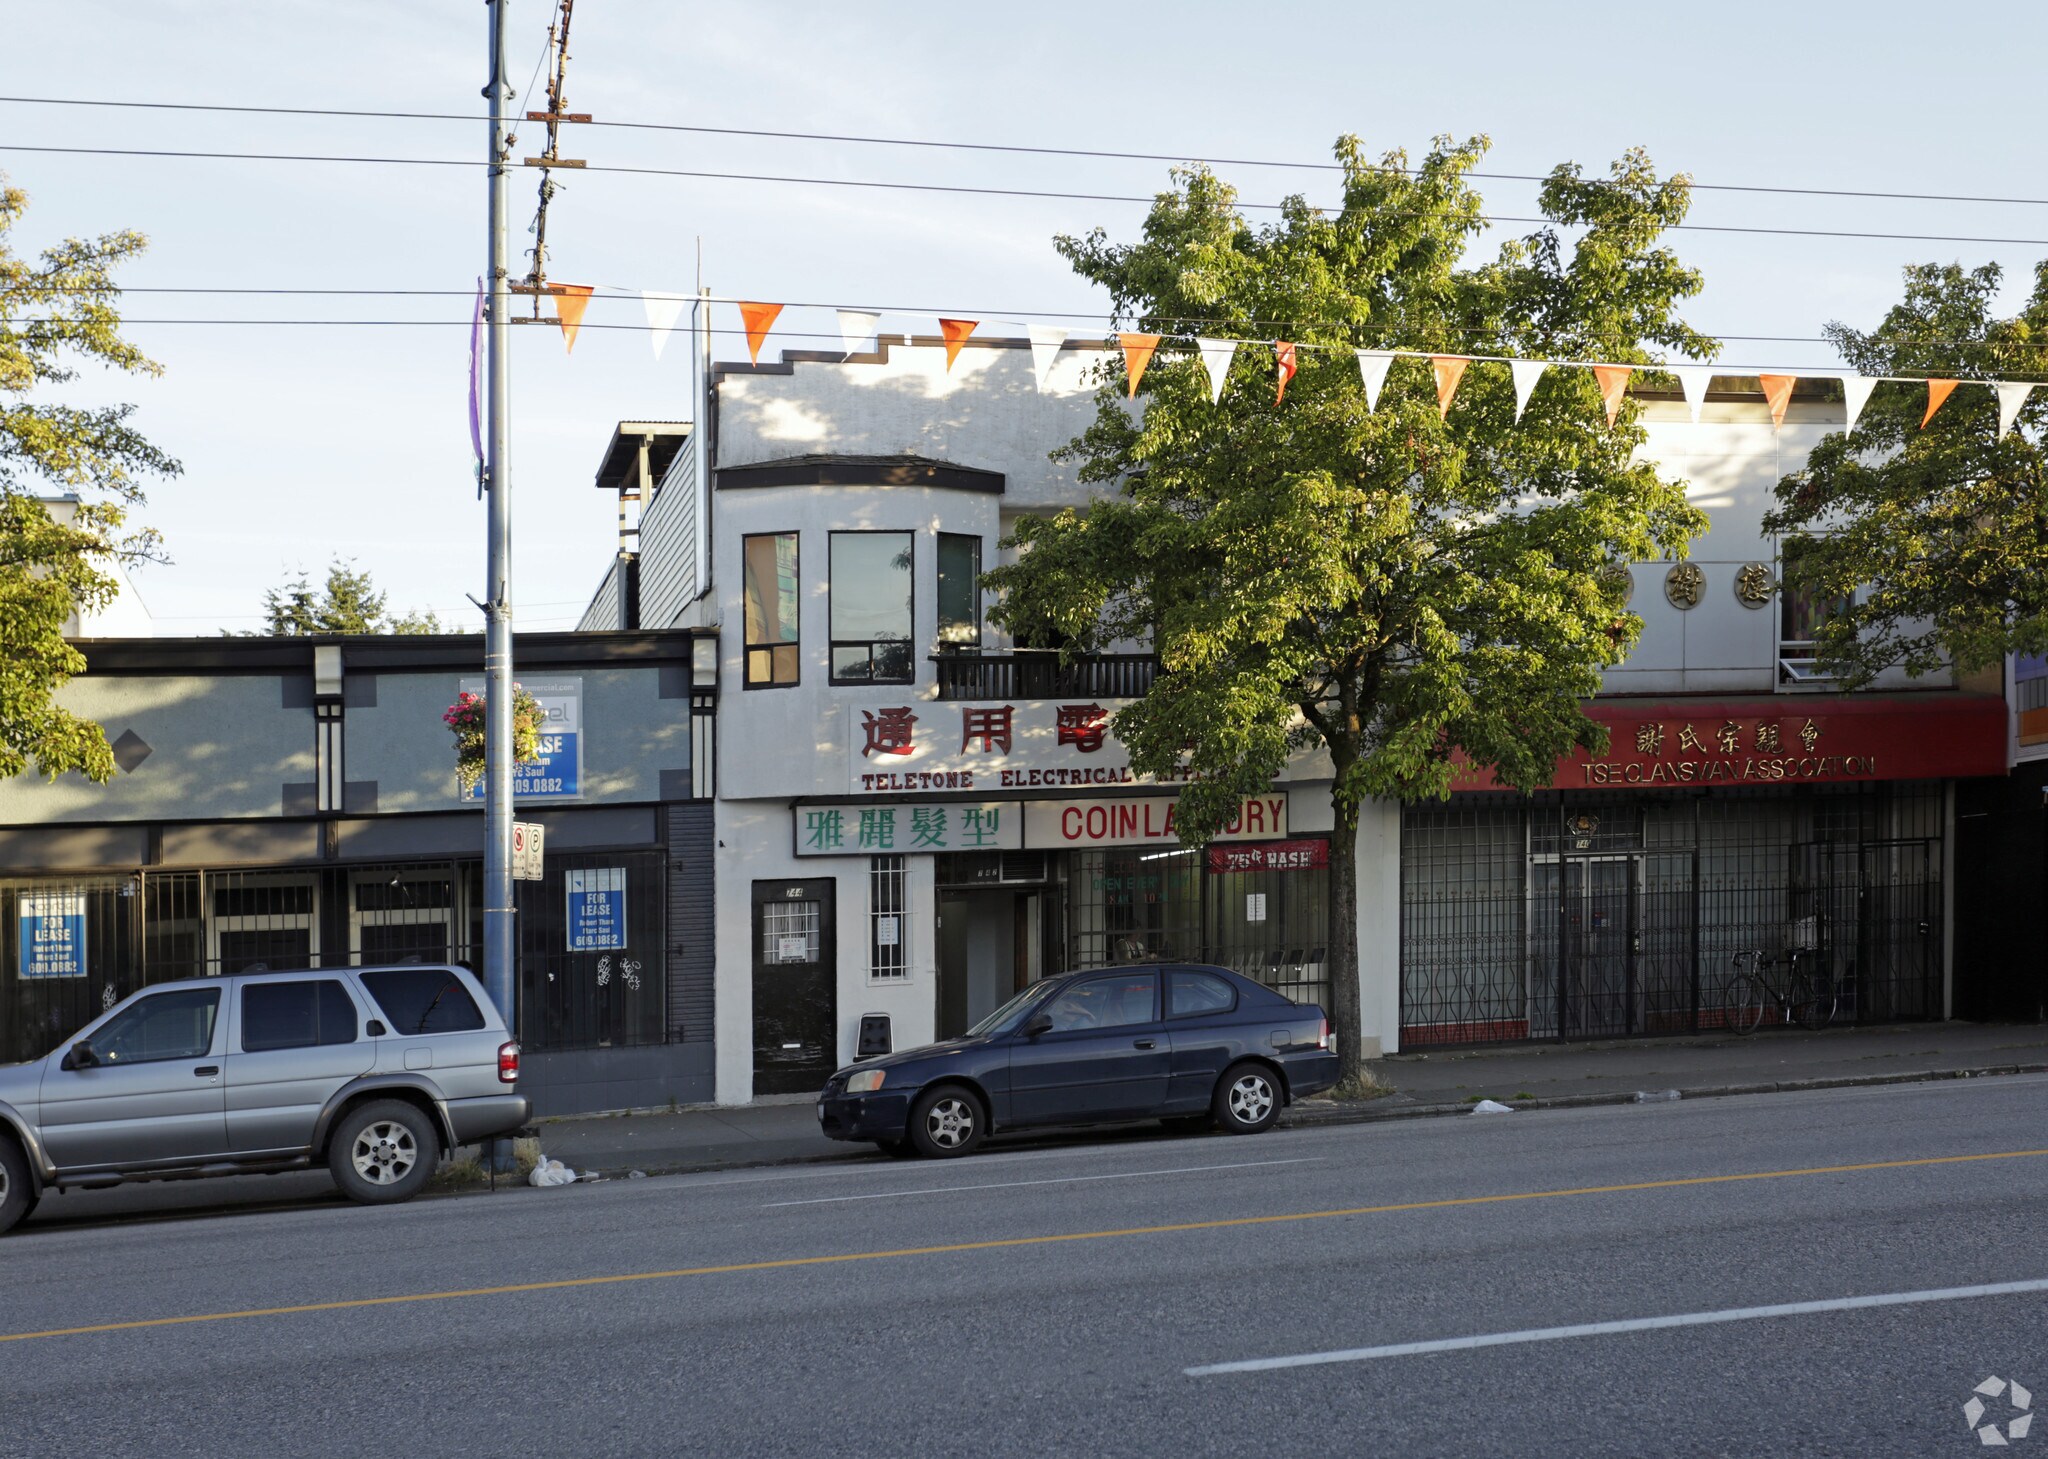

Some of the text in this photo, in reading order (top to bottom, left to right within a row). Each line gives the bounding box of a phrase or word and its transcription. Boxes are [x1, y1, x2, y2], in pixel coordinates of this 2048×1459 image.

[861, 702, 1197, 757] 通用電
[1636, 718, 1823, 756] 謝氏宗親會
[525, 766, 545, 777] Saul
[1581, 756, 1875, 784] TSE CLANSMAN ASSOCIATION
[861, 770, 974, 791] TELETONE
[1001, 766, 1133, 787] ELECTRICAL
[1145, 800, 1284, 837] LADRY
[805, 806, 1000, 849] 雅麗髮型
[1266, 851, 1312, 868] WASH
[587, 893, 606, 904] FOR
[785, 887, 804, 898] 744
[581, 904, 611, 916] LEASE
[42, 916, 64, 929] FOR
[35, 928, 71, 942] LEASE
[576, 934, 618, 946] 609.0882
